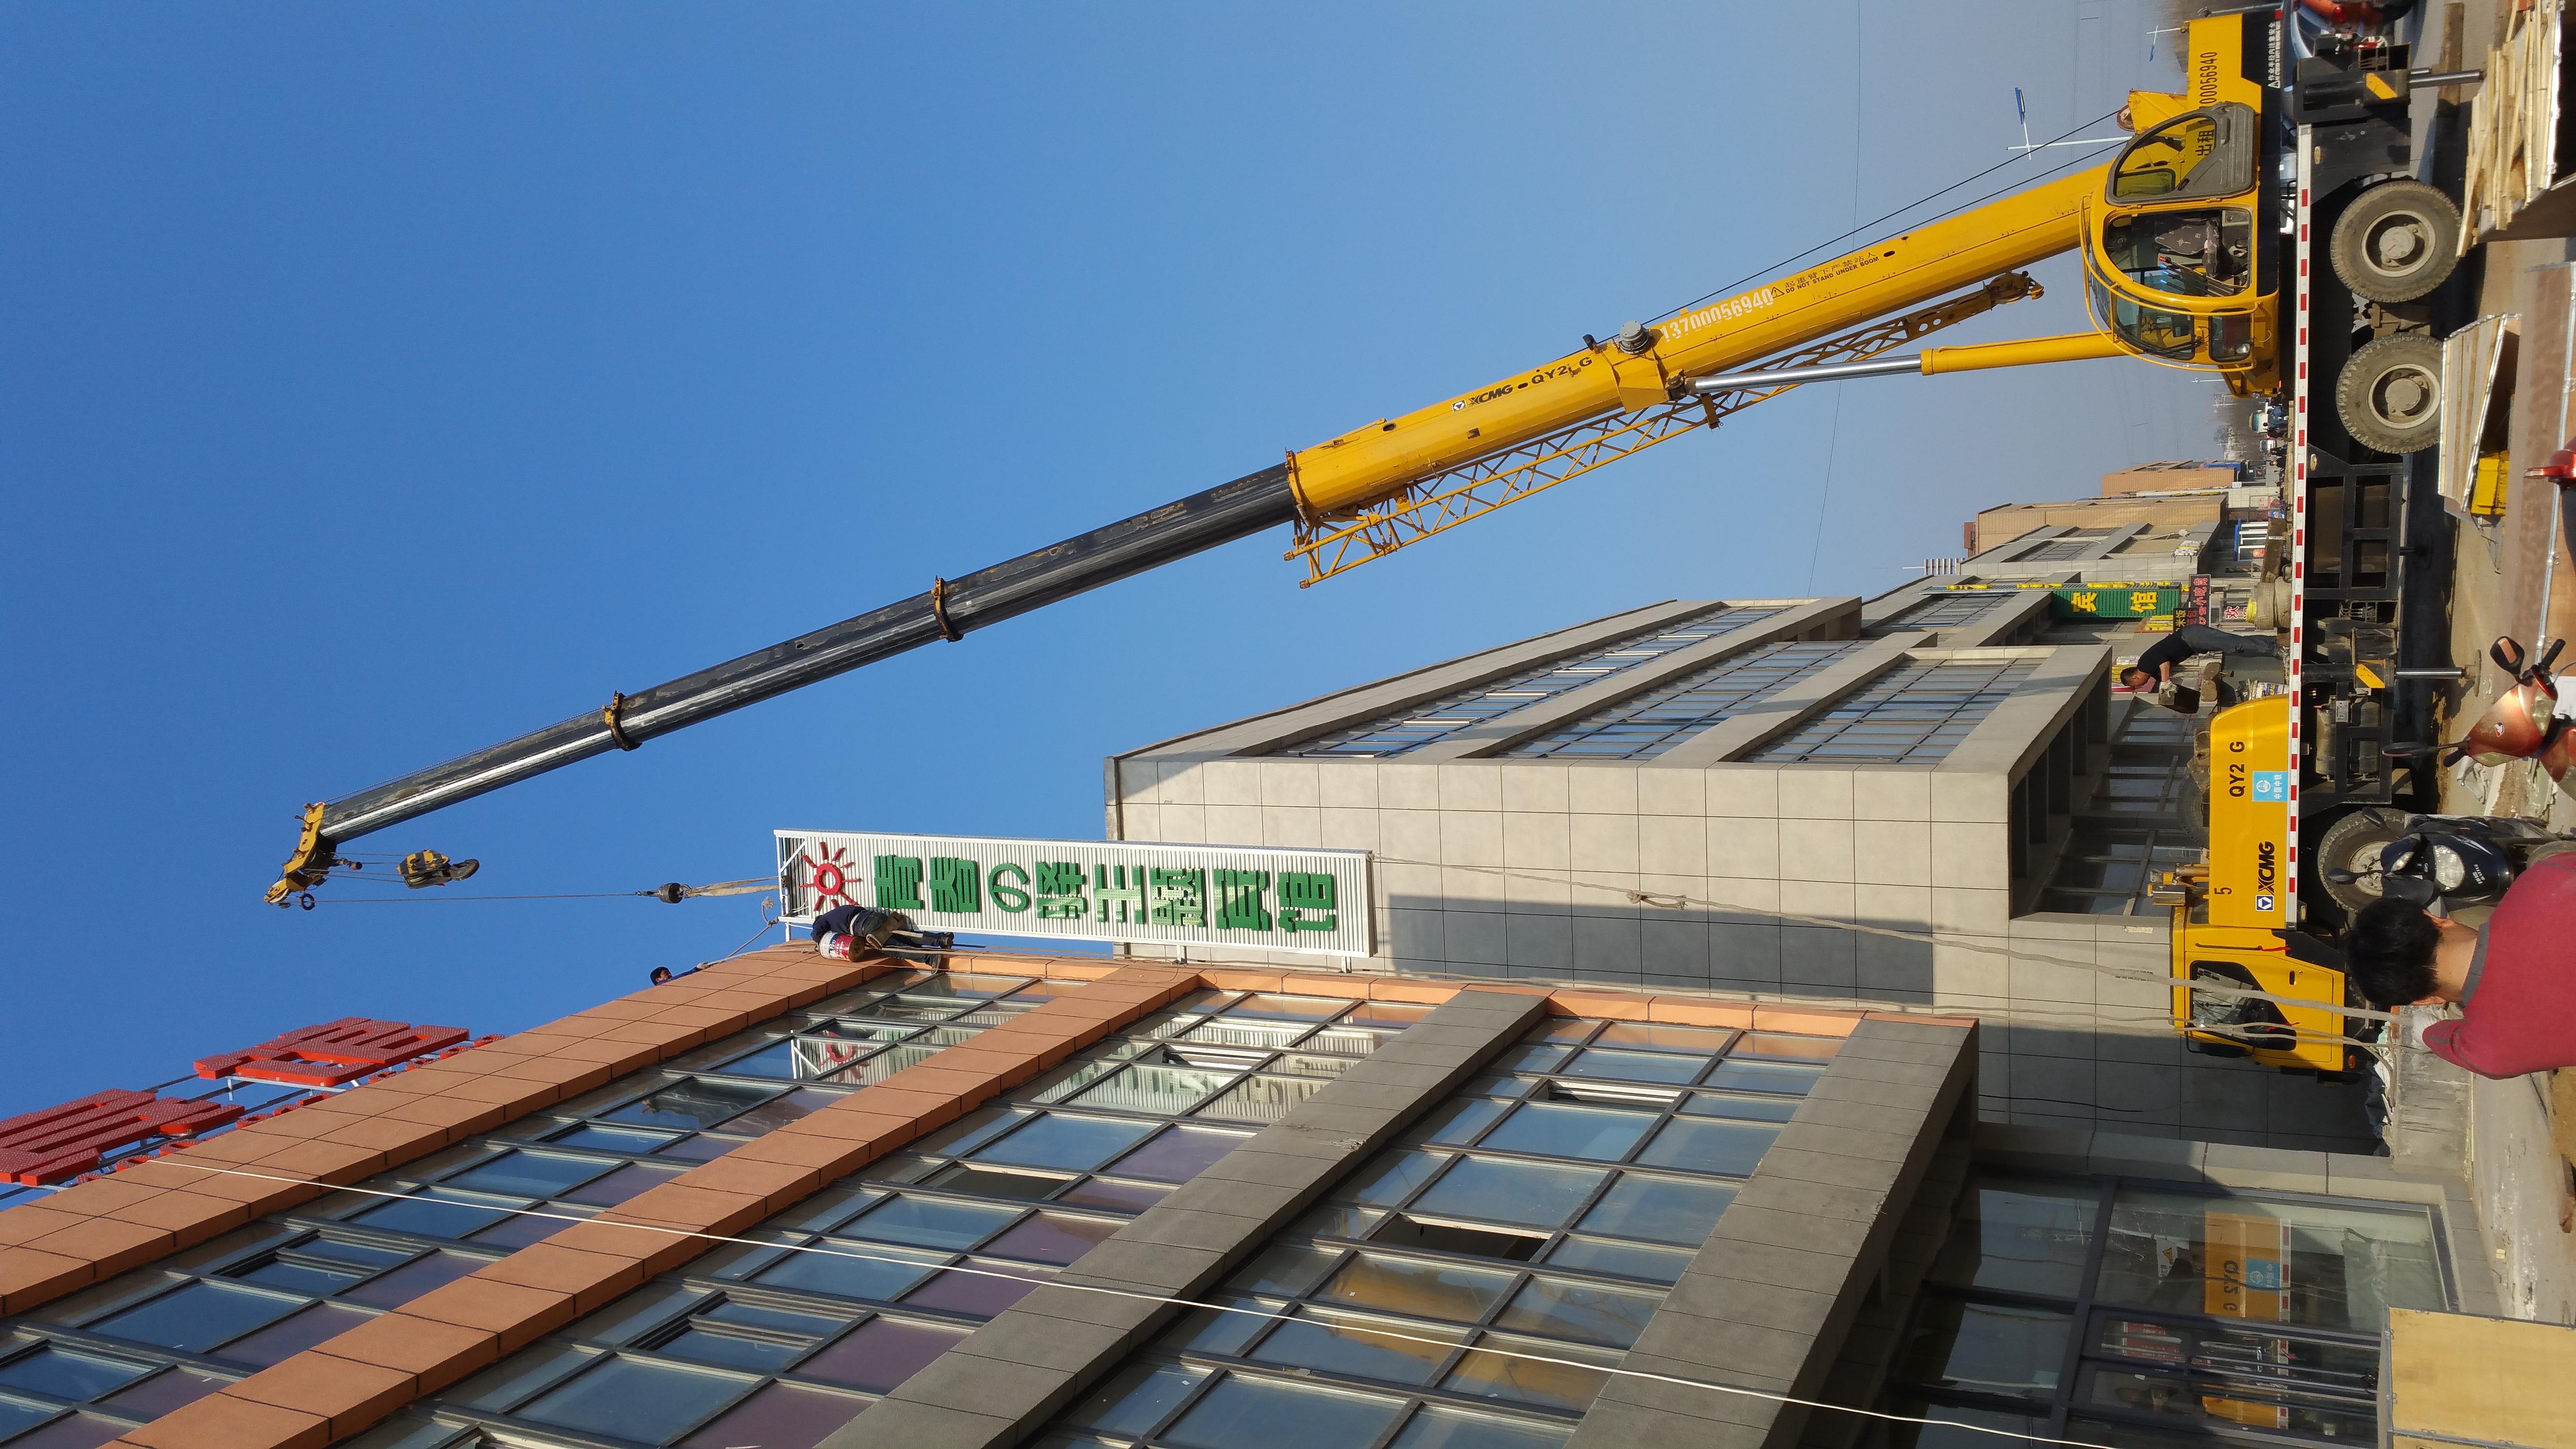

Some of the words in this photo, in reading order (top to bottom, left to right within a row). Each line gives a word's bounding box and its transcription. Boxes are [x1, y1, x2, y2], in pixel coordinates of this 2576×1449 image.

[2199, 52, 2218, 109] 00056940
[1797, 281, 1810, 290] NOT
[1813, 273, 1834, 284] STAND
[1835, 264, 1858, 275] UNDER
[1860, 256, 1879, 267] BOOM
[1659, 288, 1774, 342] 13700056940
[1468, 384, 1513, 406] XCMG
[2071, 591, 2158, 612] 宾馆
[2175, 610, 2186, 631] 米饭
[2273, 774, 2283, 799] 中国中铁
[2258, 841, 2275, 895] XCMG
[873, 854, 1336, 933] 青春の驿主题宾馆
[2214, 887, 2232, 895] 5
